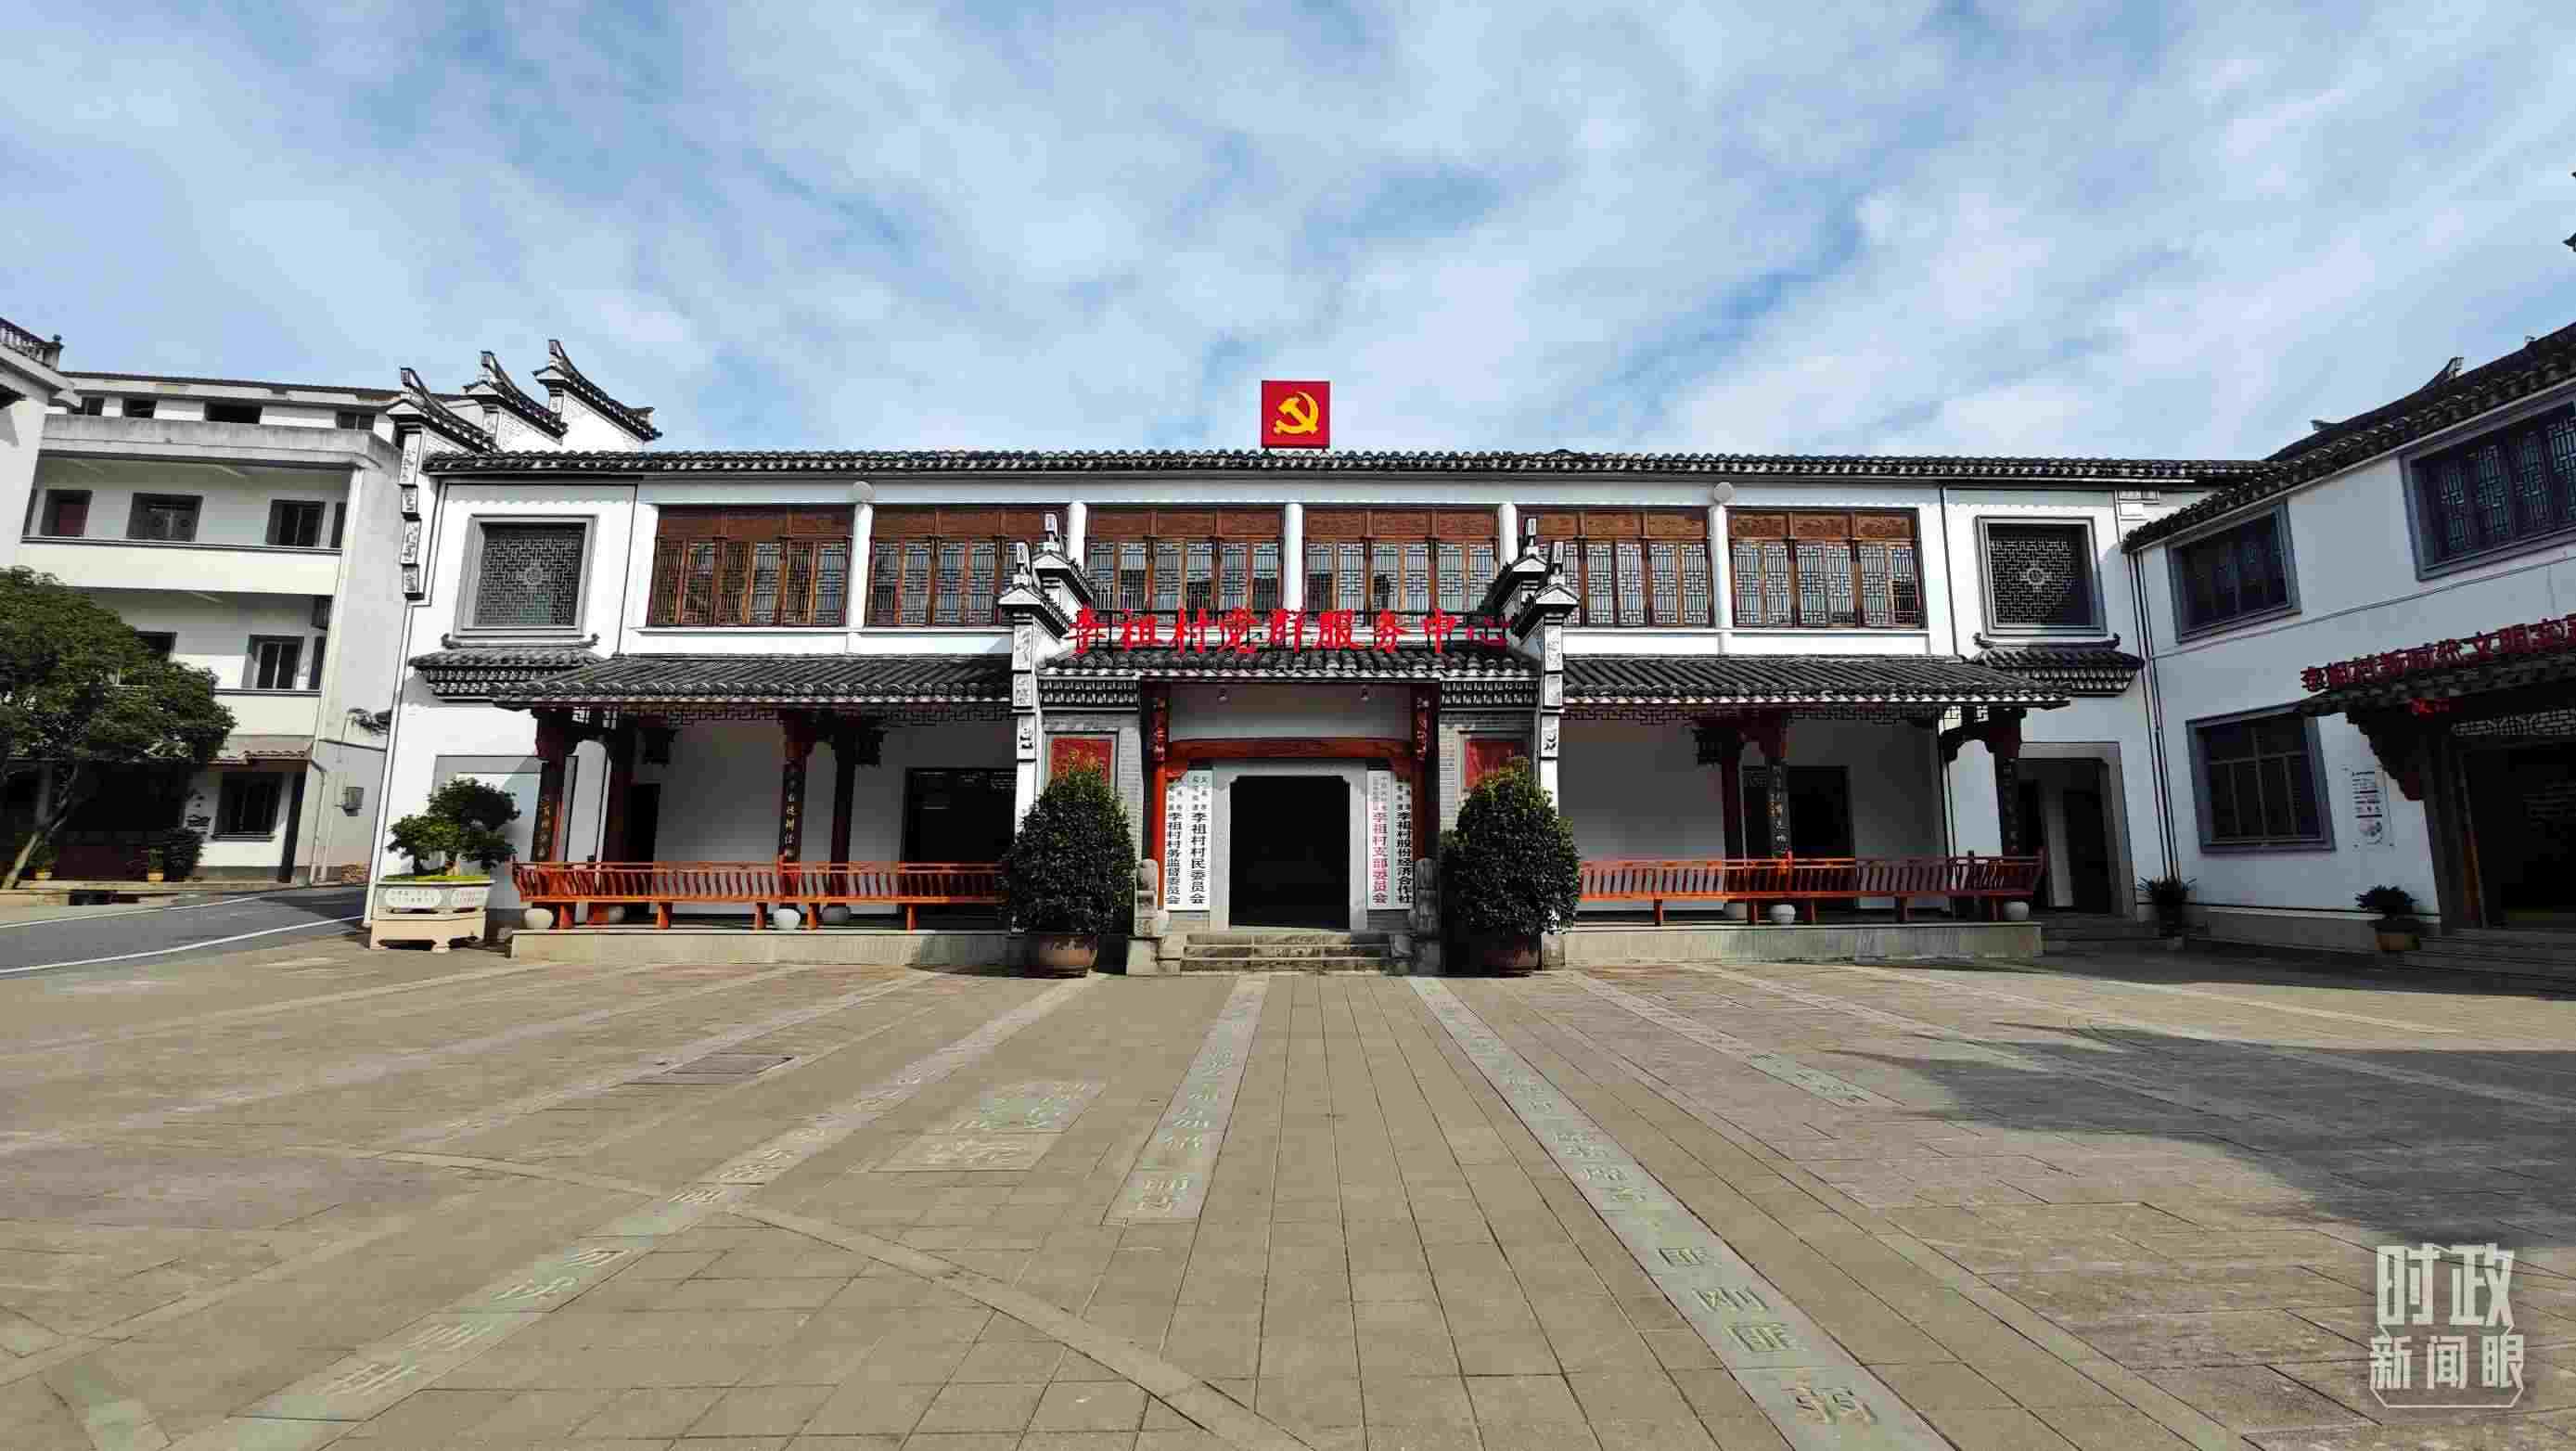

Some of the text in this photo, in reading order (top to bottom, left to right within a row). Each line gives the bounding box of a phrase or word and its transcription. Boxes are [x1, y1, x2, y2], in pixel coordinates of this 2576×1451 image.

[1069, 605, 1514, 653] 李祖村党群服务中心
[1190, 812, 1208, 905] 李祖村村民委员会
